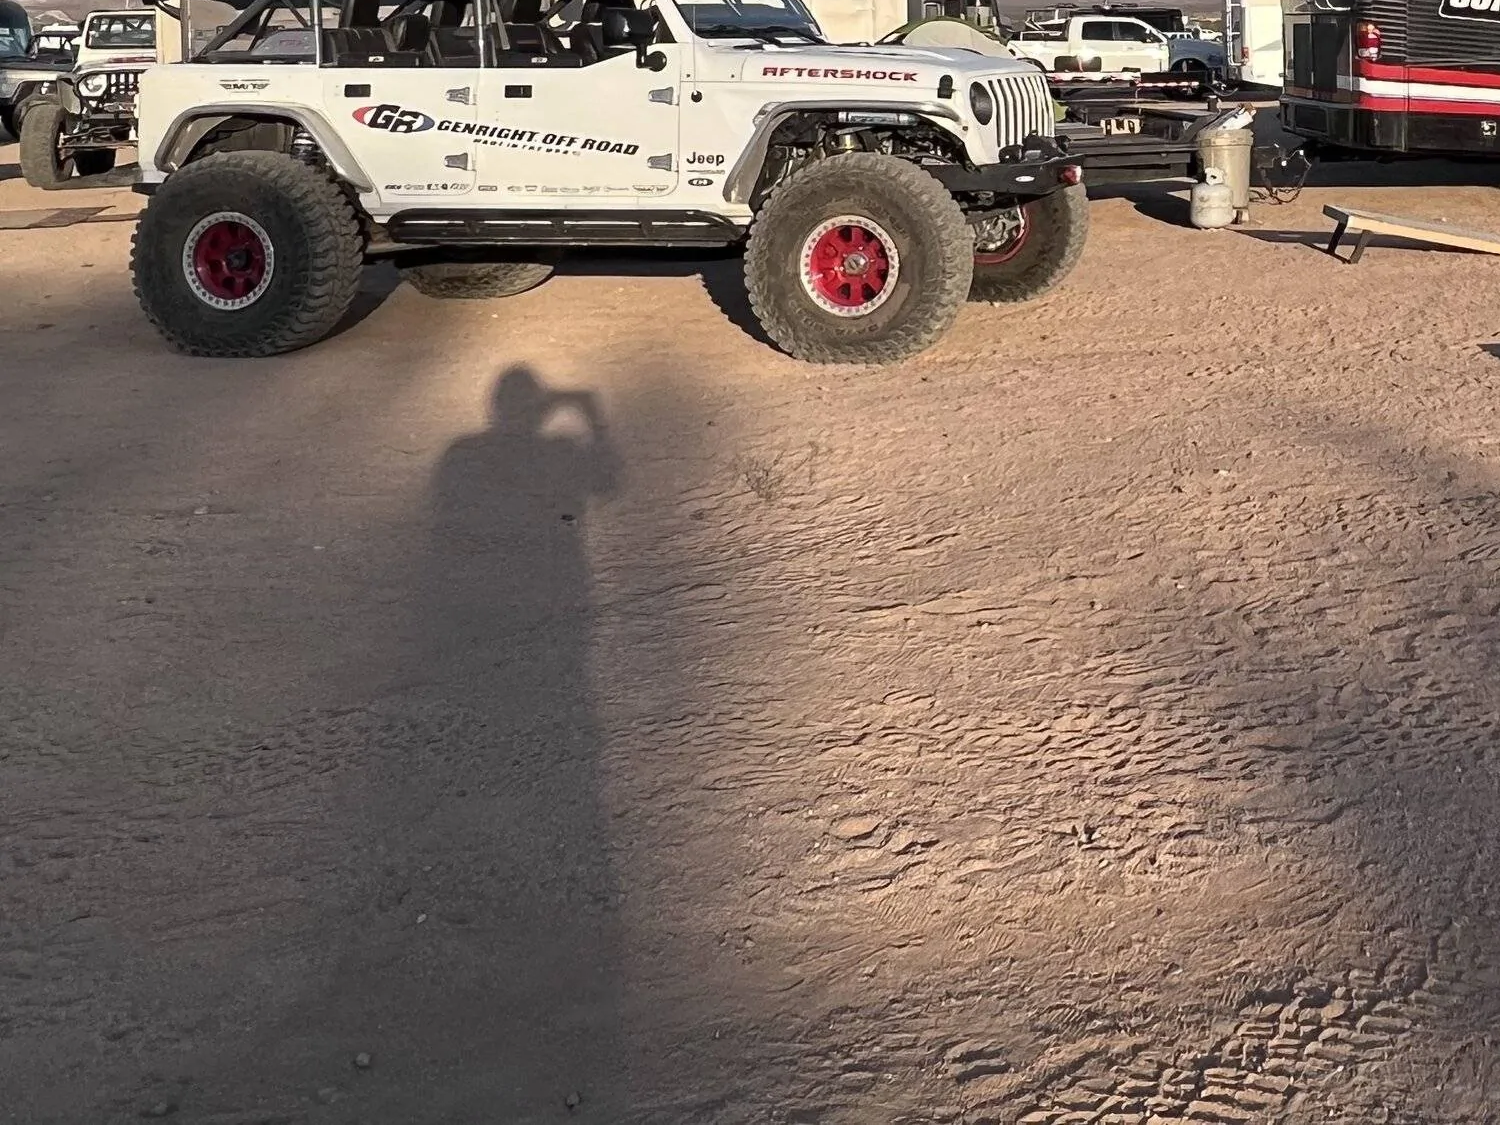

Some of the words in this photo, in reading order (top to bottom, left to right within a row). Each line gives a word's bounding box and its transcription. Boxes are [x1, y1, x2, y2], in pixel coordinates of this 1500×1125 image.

[762, 66, 918, 82] AFTERSHOCK
[368, 104, 420, 133] GR
[437, 120, 538, 143] GENRIGHT
[542, 133, 580, 148] OFF
[580, 138, 640, 155] ROAD
[686, 151, 725, 166] Jeep
